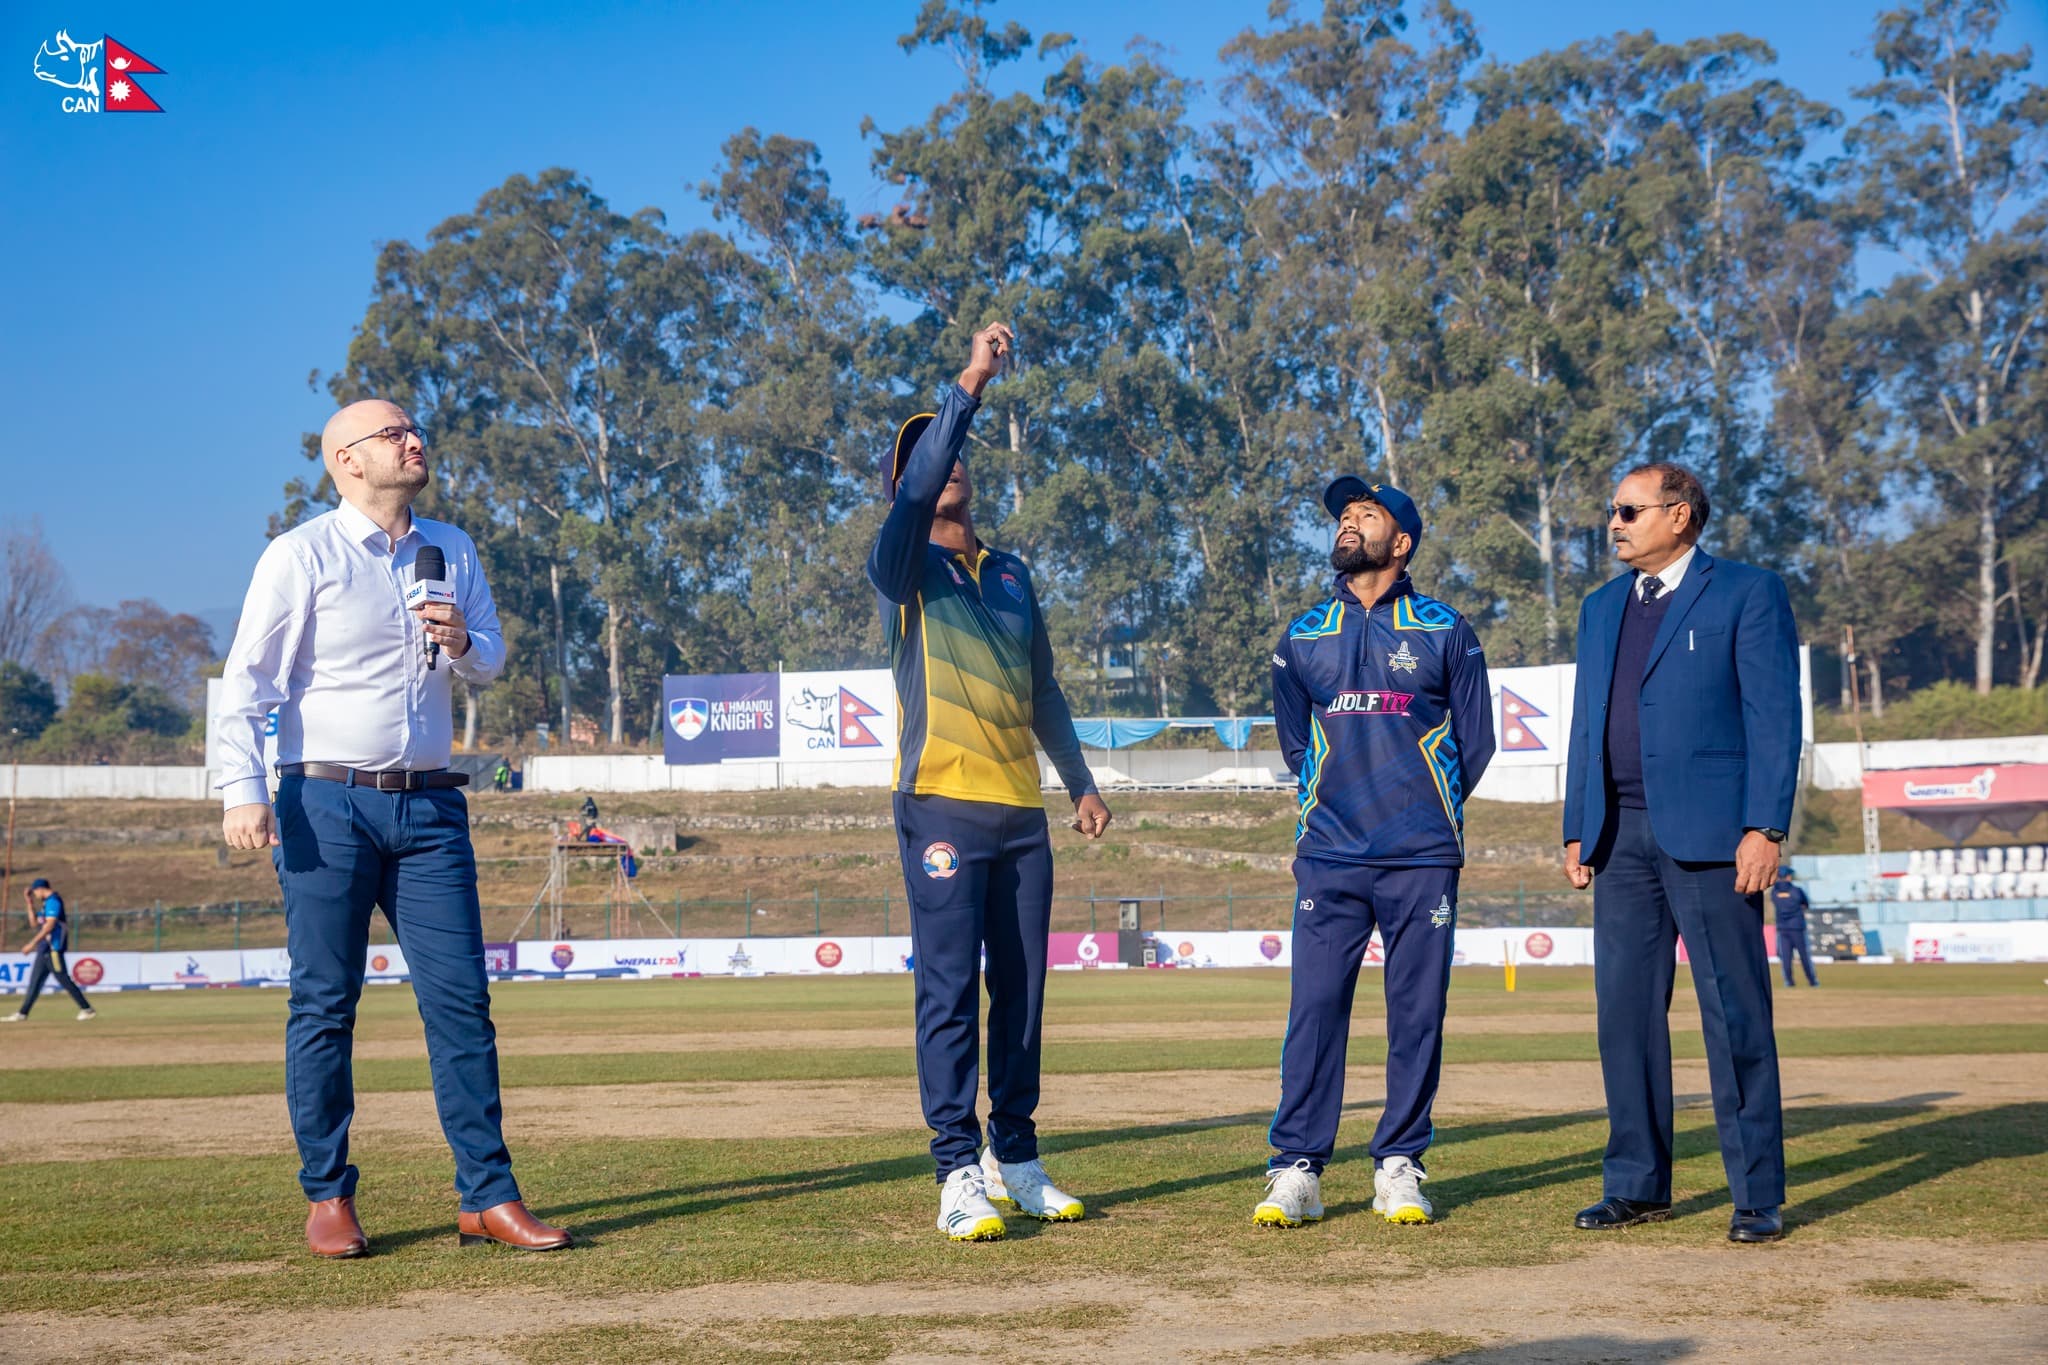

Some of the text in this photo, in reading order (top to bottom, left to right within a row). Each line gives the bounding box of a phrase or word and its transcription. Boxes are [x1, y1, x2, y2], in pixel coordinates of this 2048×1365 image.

[711, 700, 773, 713] KATHMANDU
[711, 711, 774, 731] KNIGHTS
[807, 736, 835, 749] CAN
[1078, 934, 1100, 960] 6
